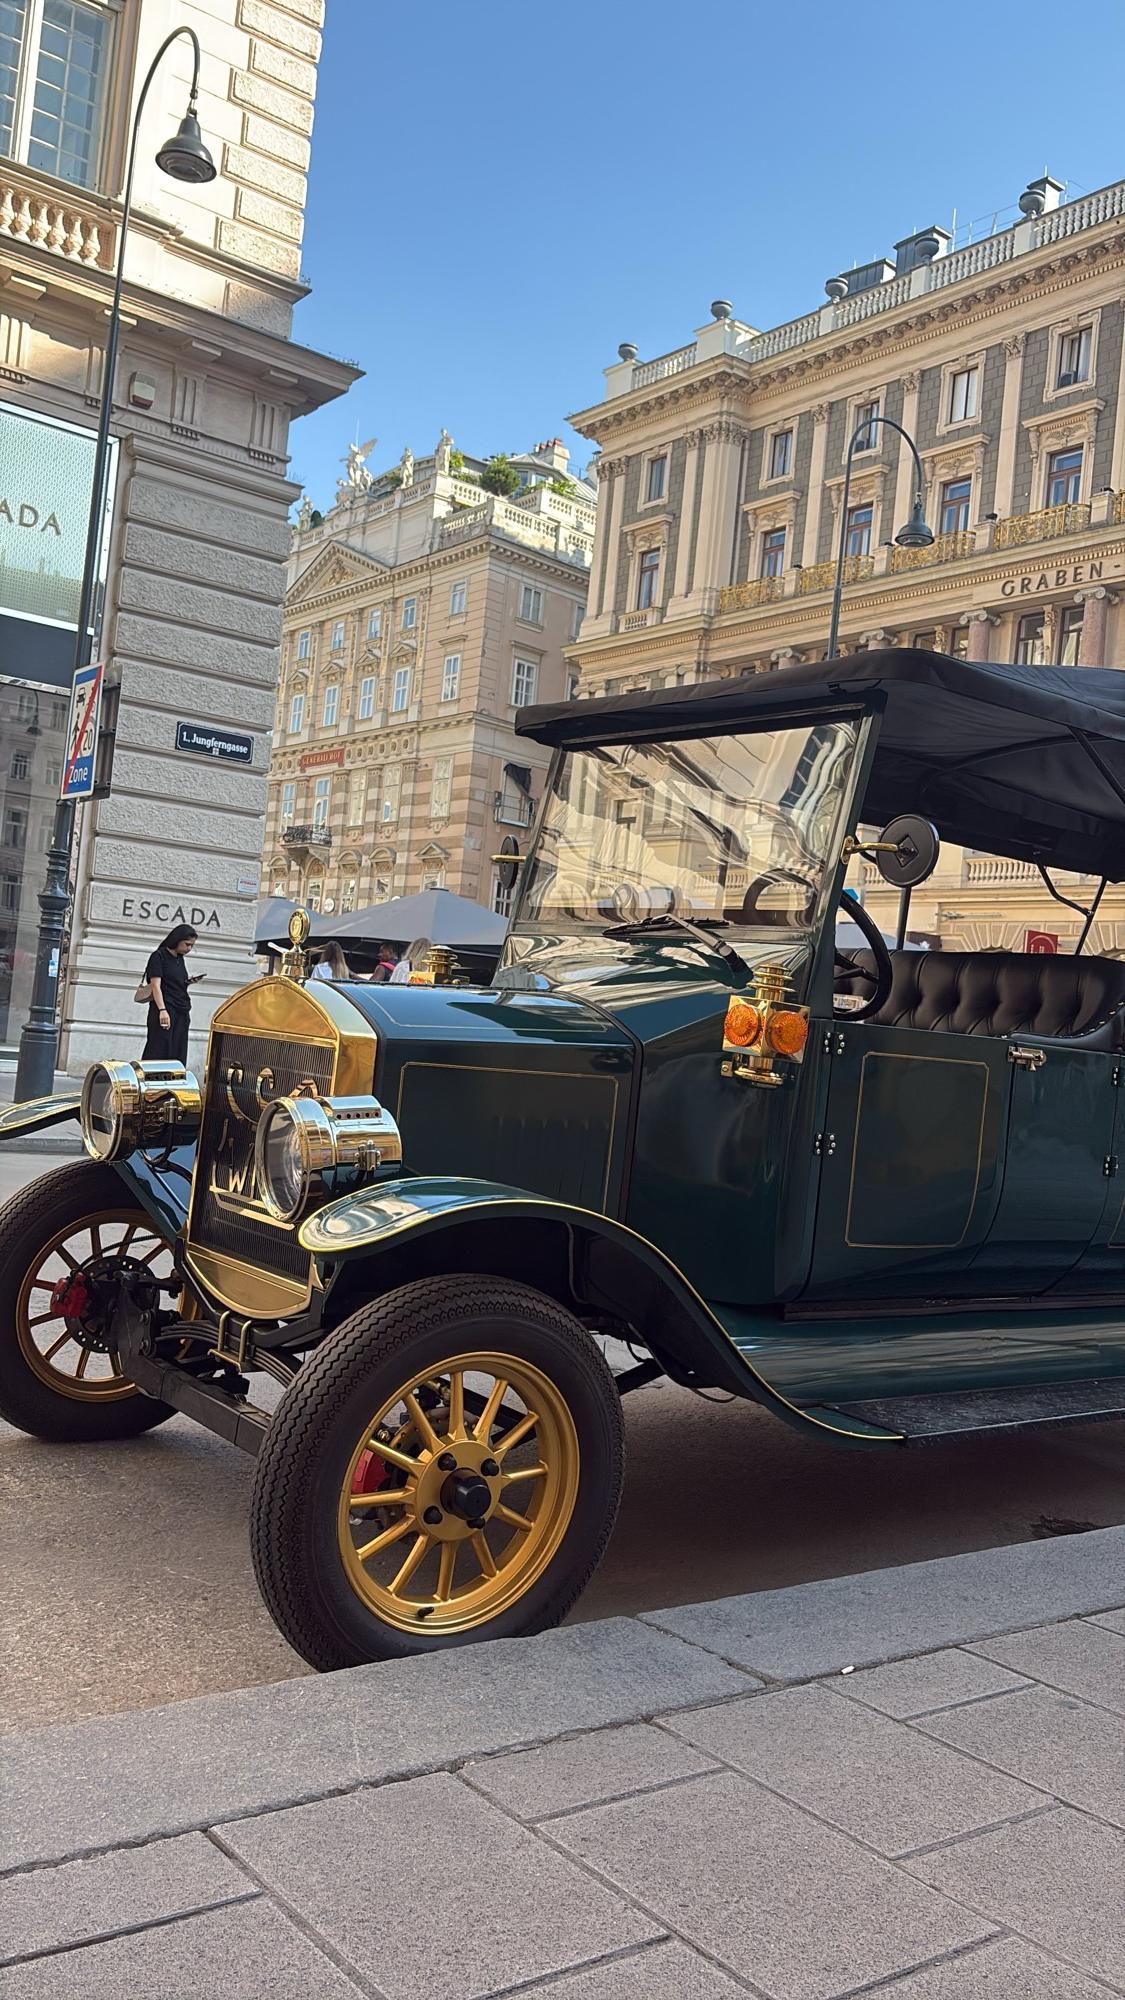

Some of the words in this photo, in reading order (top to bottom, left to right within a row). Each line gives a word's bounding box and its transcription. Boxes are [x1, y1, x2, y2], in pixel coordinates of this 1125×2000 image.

[1001, 562, 1103, 597] GRABEN
[82, 728, 94, 752] 20
[183, 731, 190, 743] 1.
[191, 733, 248, 754] Jungferngasse
[68, 765, 88, 784] Zone
[122, 898, 221, 928] ESCADA
